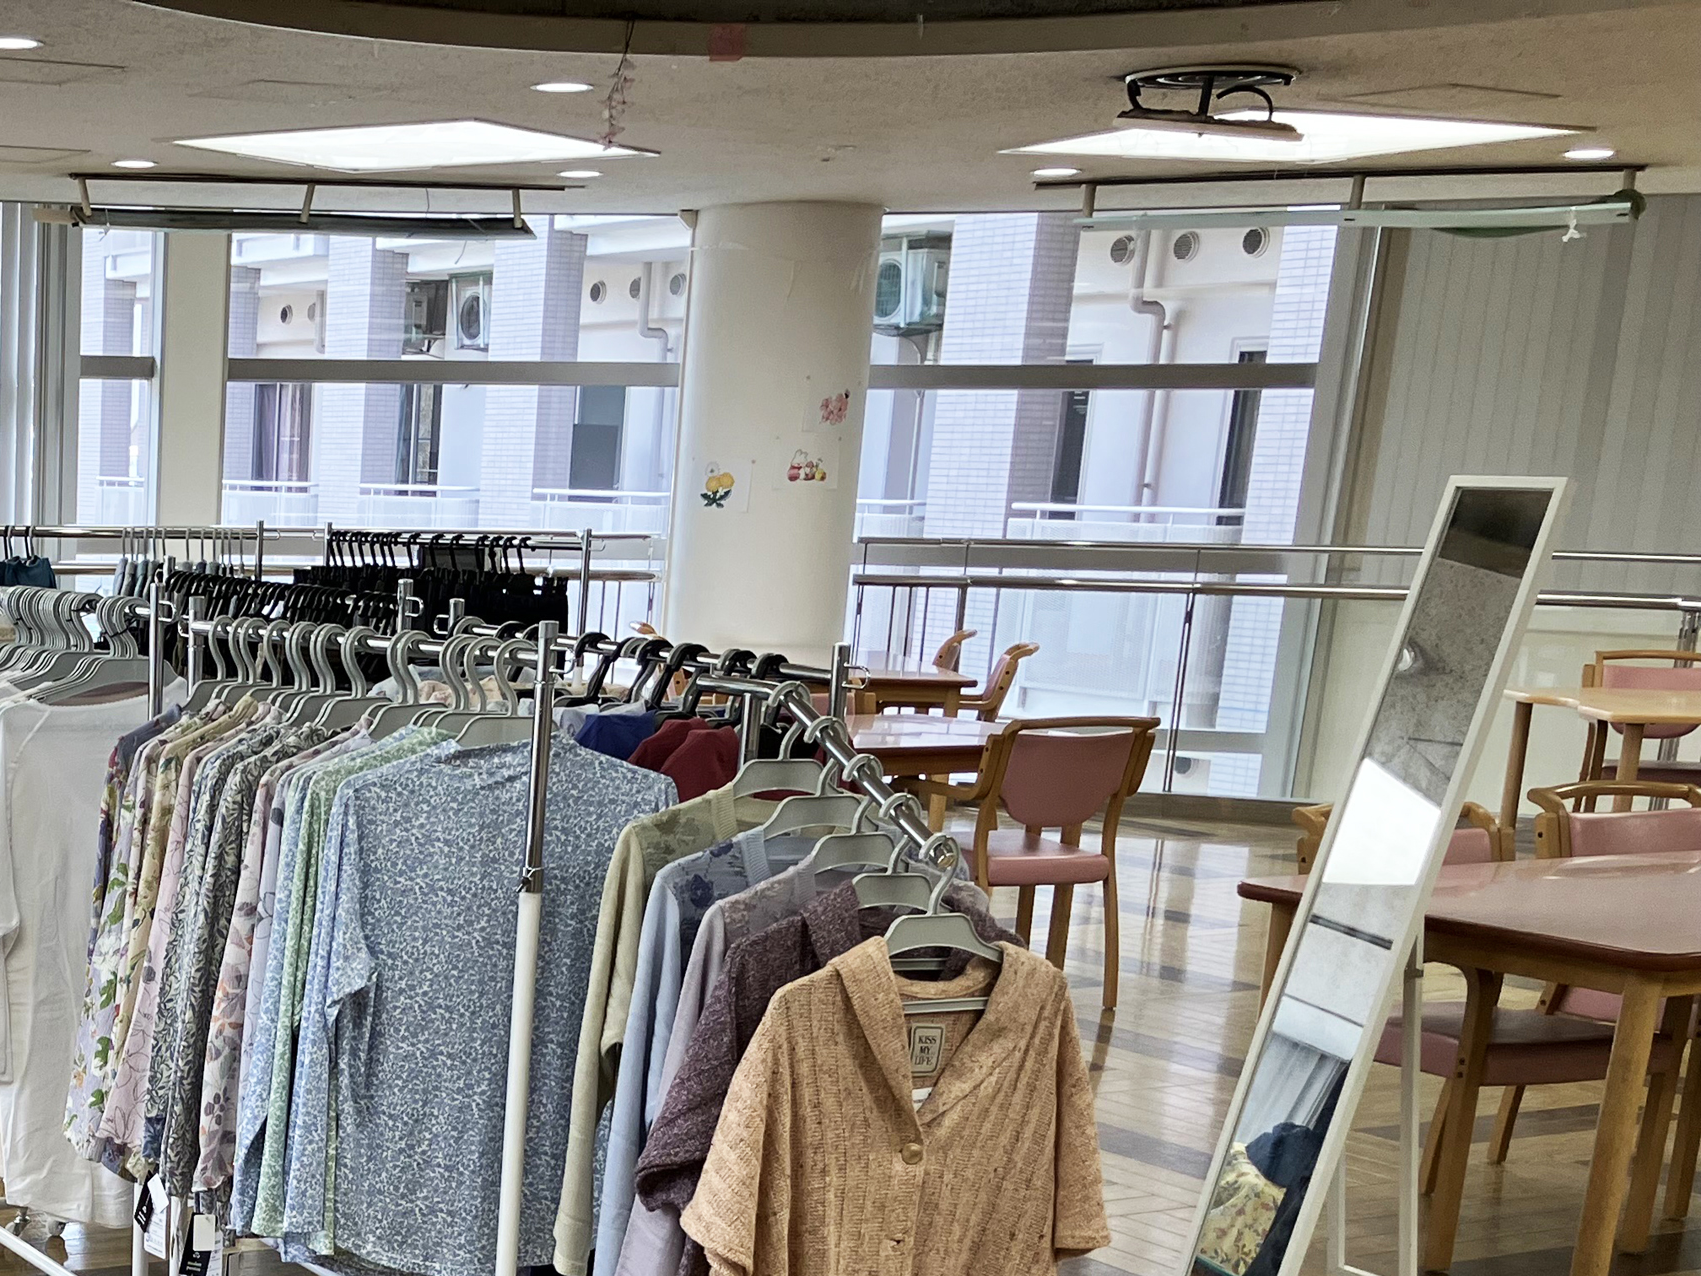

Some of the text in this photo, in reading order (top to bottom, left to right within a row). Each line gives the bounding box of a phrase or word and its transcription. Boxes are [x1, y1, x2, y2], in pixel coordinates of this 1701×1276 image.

[918, 1035, 937, 1044] KISS
[920, 1046, 931, 1055] MY
[914, 1055, 933, 1066] LIFE
